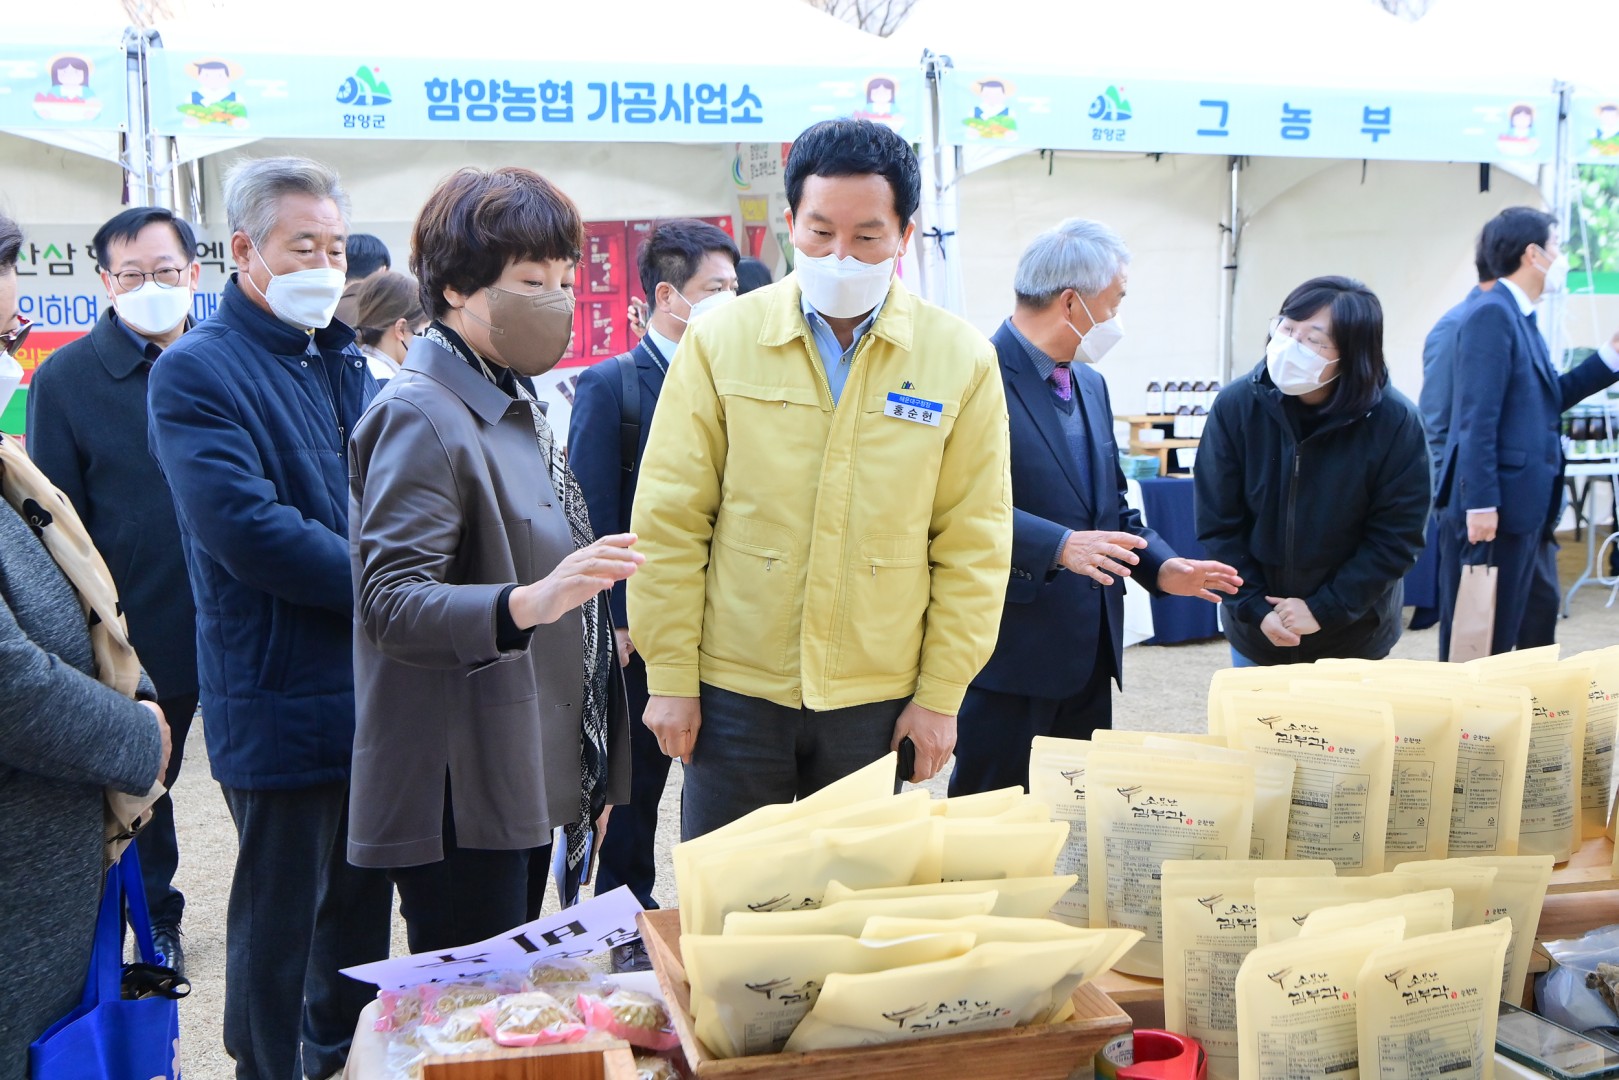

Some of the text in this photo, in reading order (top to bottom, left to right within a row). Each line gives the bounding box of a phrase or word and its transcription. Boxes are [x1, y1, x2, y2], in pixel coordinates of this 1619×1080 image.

[424, 77, 764, 124] 함양농협 가공사업소
[343, 114, 386, 129] 함양군
[1092, 128, 1126, 141] 함양군
[16, 243, 77, 276] 산삼
[1275, 732, 1328, 750] 김부각
[1131, 806, 1186, 823] 김부각
